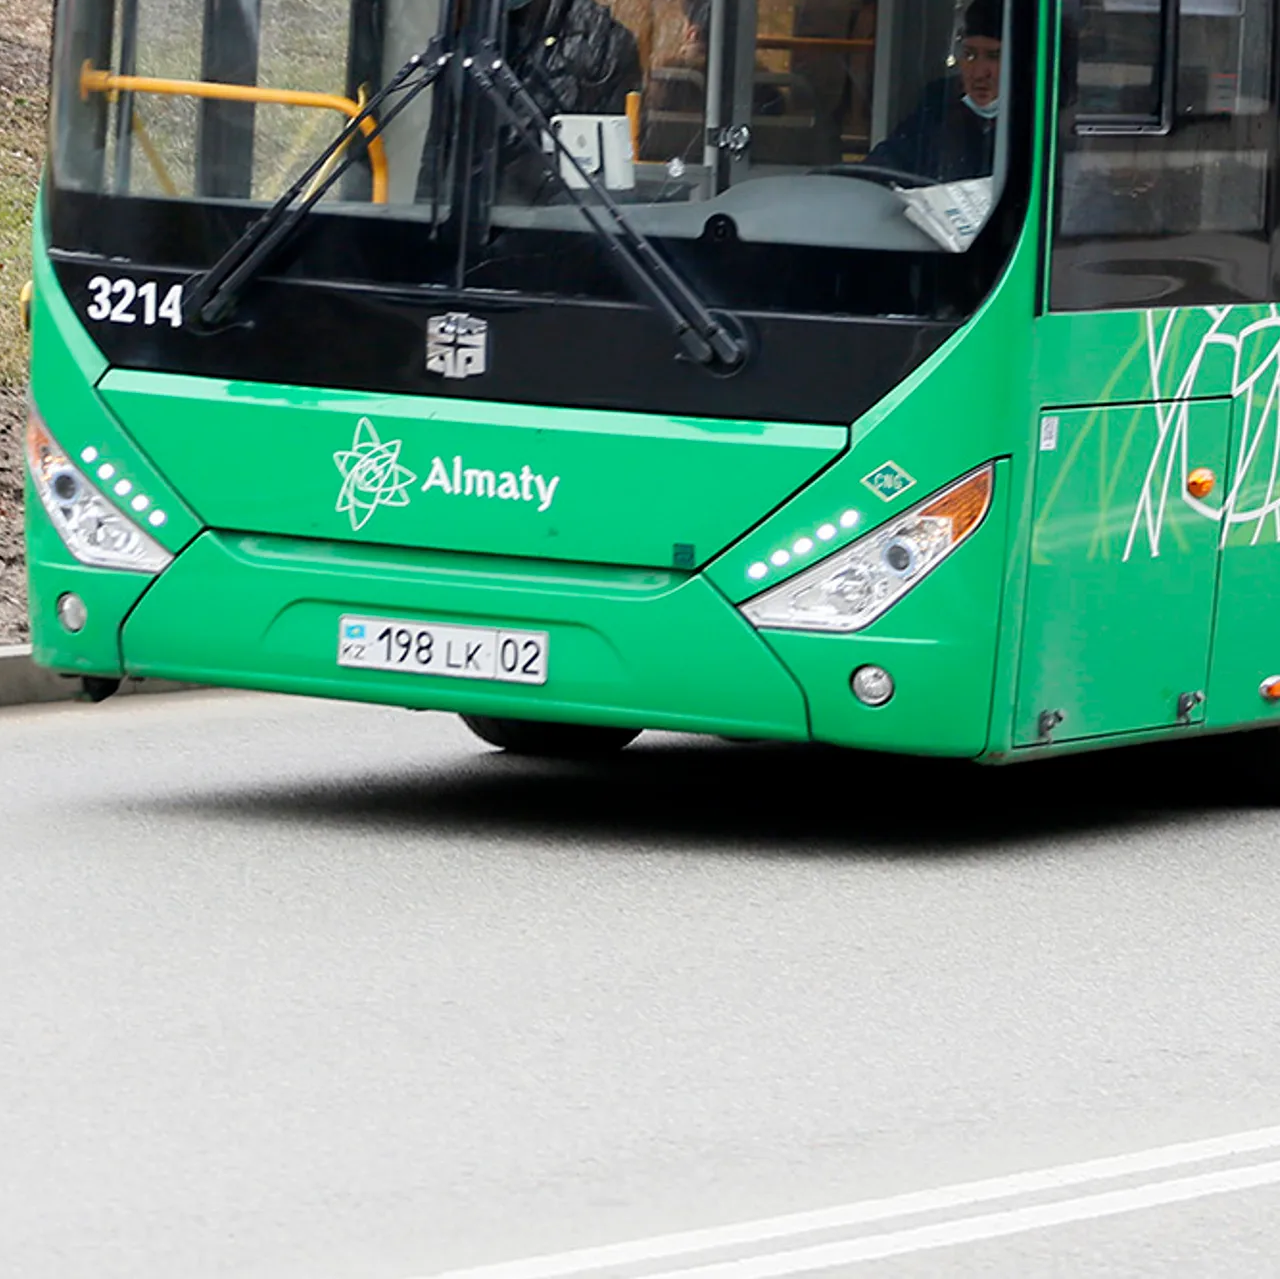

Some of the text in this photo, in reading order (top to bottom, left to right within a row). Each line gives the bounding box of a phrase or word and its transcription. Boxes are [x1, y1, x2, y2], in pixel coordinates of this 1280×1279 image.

[87, 276, 183, 327] 3214
[421, 455, 561, 513] Almaty
[377, 626, 434, 666] 198
[446, 640, 483, 671] LK
[500, 638, 541, 676] 02
